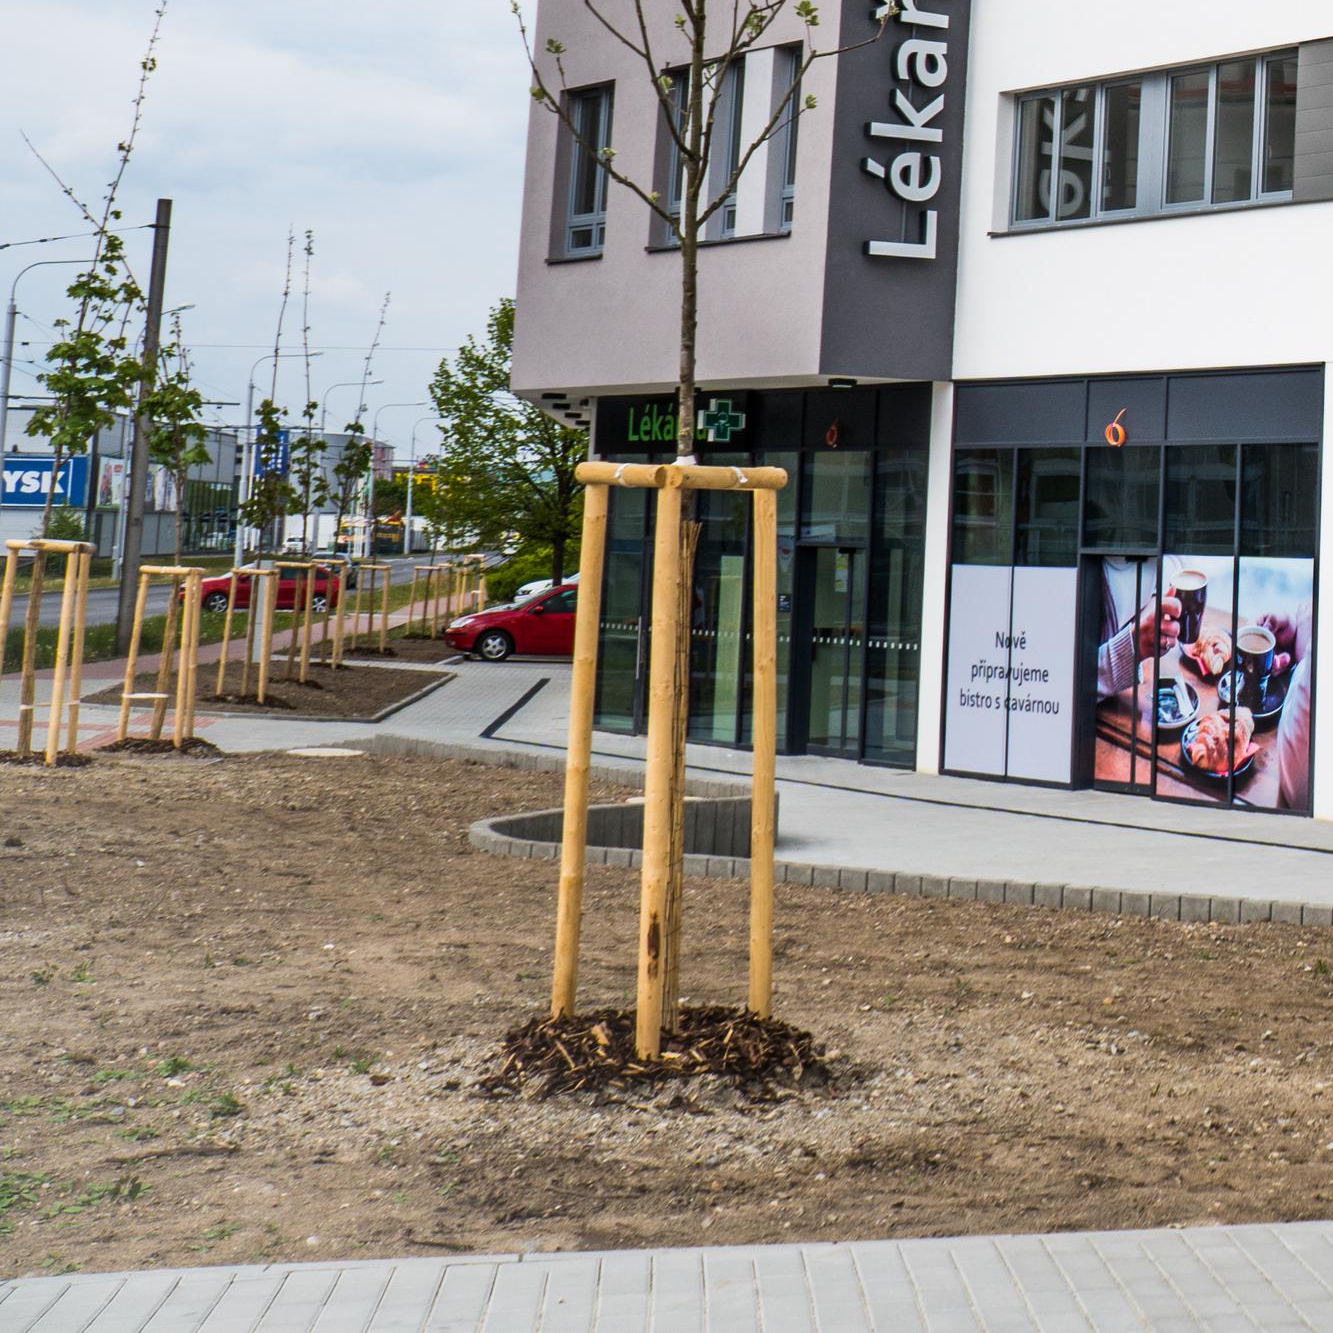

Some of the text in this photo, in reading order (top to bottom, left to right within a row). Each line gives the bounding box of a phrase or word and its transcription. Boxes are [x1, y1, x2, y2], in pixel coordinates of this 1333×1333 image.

[627, 402, 708, 442] Léká
[995, 631, 1027, 650] Nově
[960, 688, 992, 709] bistro
[995, 695, 1001, 710] s
